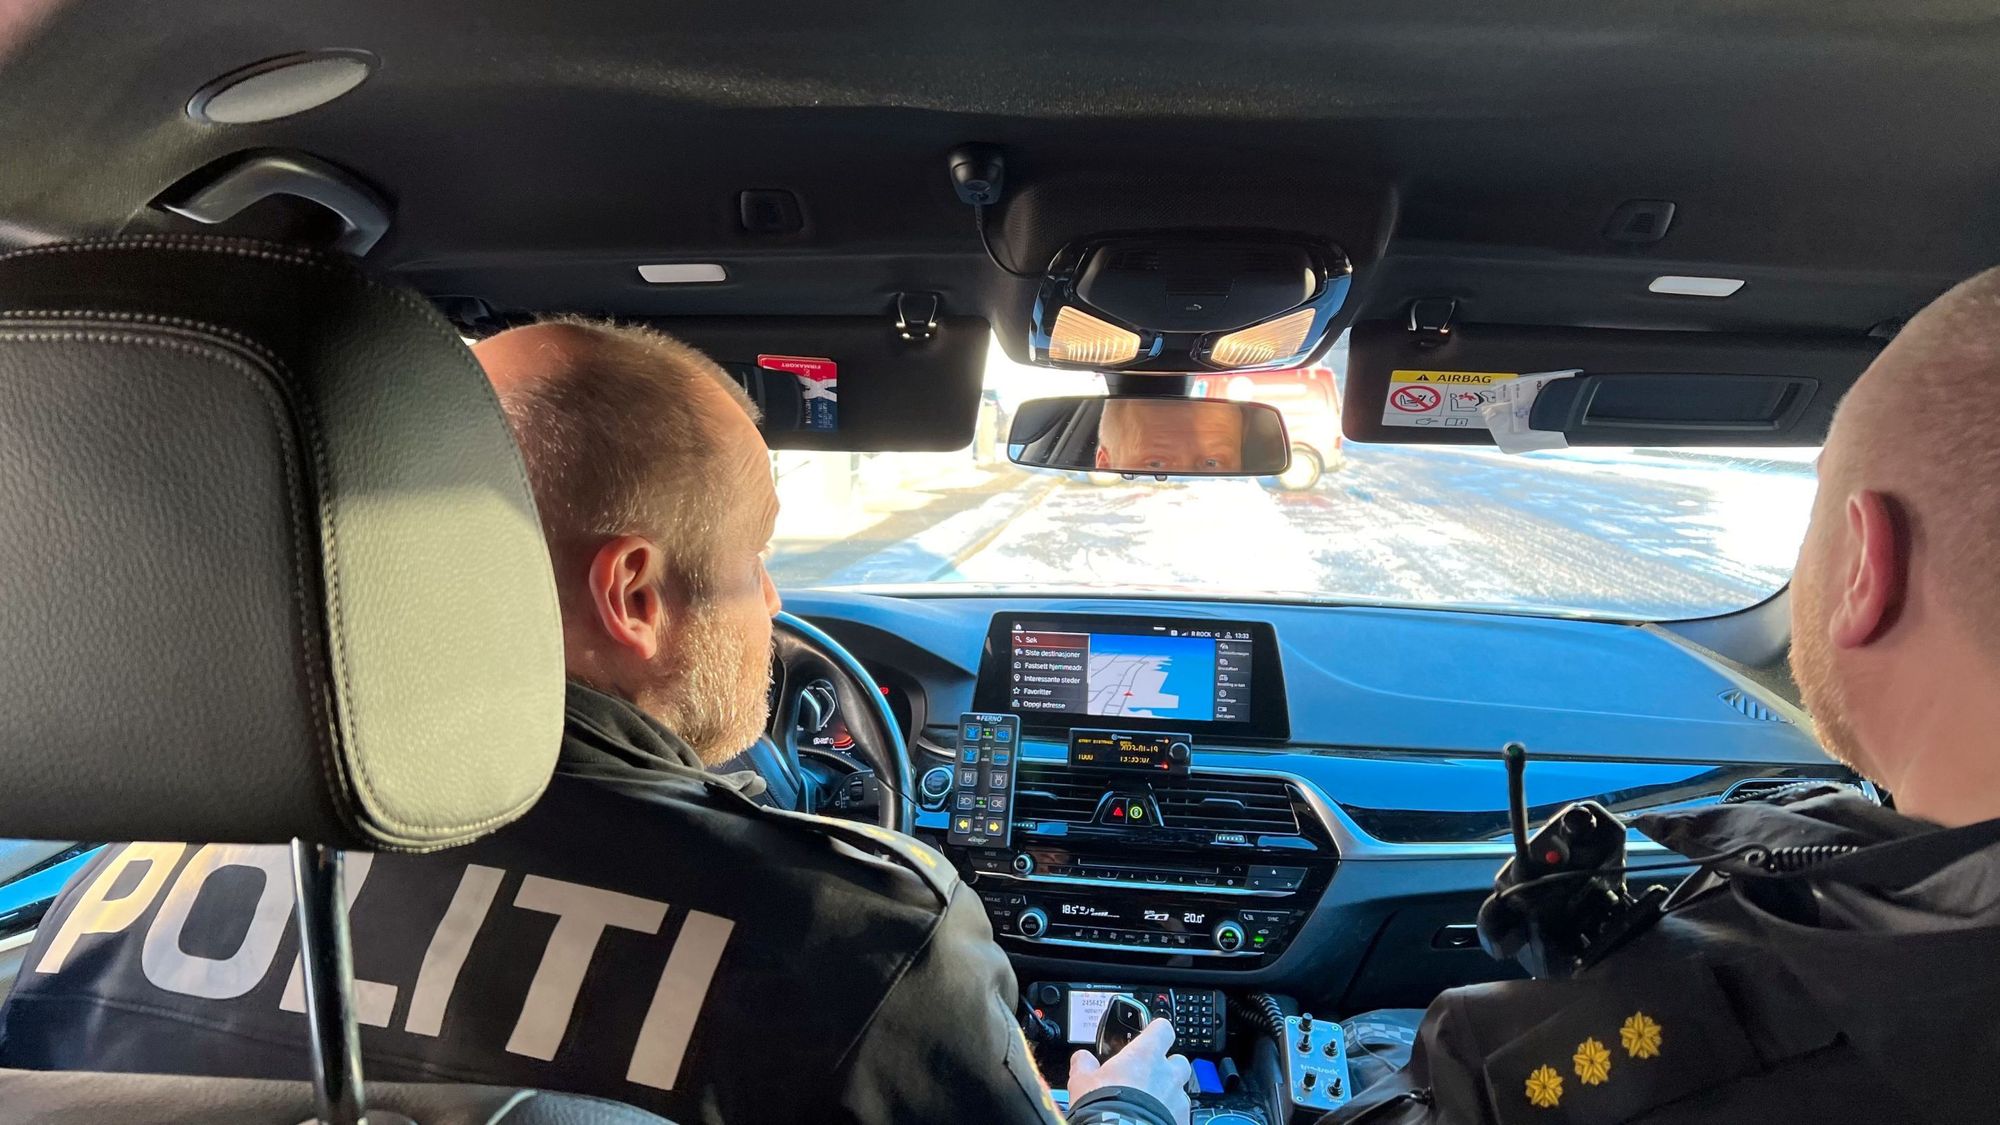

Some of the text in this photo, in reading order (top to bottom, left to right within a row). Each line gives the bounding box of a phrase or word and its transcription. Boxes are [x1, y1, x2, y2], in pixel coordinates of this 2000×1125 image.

[1437, 374, 1492, 384] AIRBAG
[1040, 650, 1080, 658] destinasjoner
[1049, 663, 1083, 671] hjemmeadr.
[1024, 675, 1060, 683] Interessante
[35, 842, 735, 1091] POLITI
